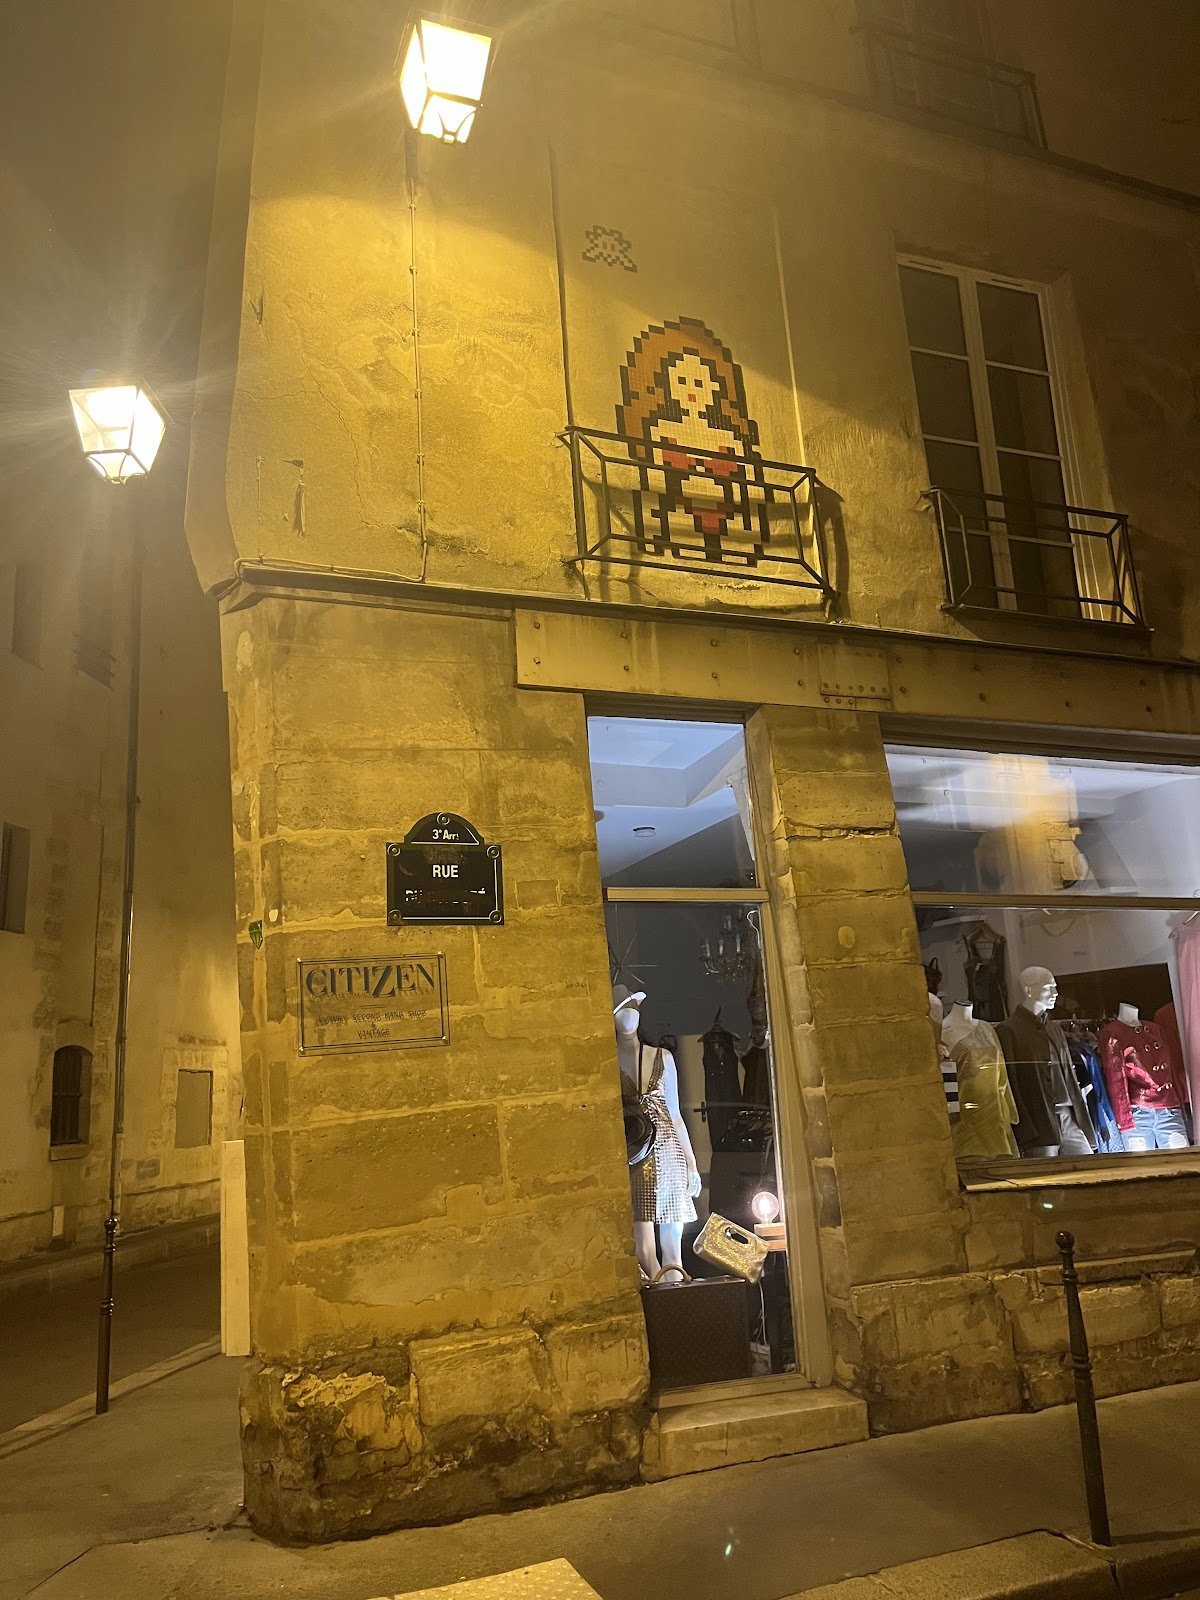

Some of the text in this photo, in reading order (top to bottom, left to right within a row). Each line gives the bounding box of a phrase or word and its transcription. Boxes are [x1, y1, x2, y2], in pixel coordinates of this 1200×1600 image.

[432, 864, 459, 878] RUE
[306, 963, 437, 998] CITIZEN
[357, 1029, 391, 1039] VINTAGE
